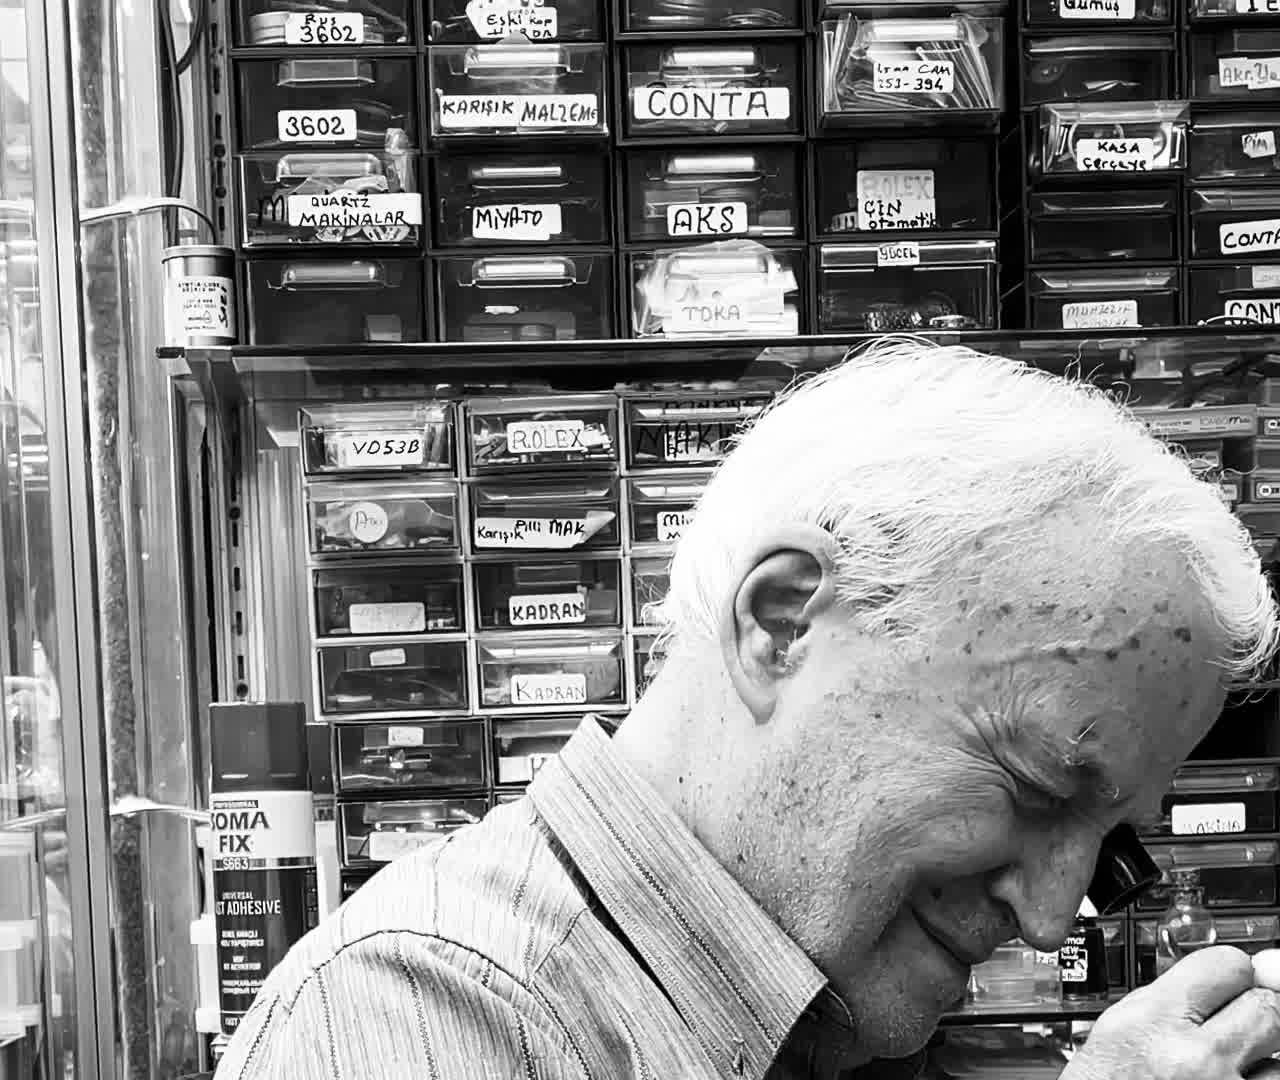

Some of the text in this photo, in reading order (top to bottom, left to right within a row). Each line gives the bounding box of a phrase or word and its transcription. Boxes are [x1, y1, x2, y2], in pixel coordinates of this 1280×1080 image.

[300, 25, 357, 43] 3602
[648, 90, 769, 118] CONTA
[285, 117, 346, 137] 3602
[1098, 142, 1140, 153] KASA
[673, 205, 736, 234] AKS
[512, 429, 584, 450] ROLEX
[513, 601, 585, 621] KADRAN
[219, 834, 251, 853] FIX
[226, 899, 281, 916] ADHESIVE
